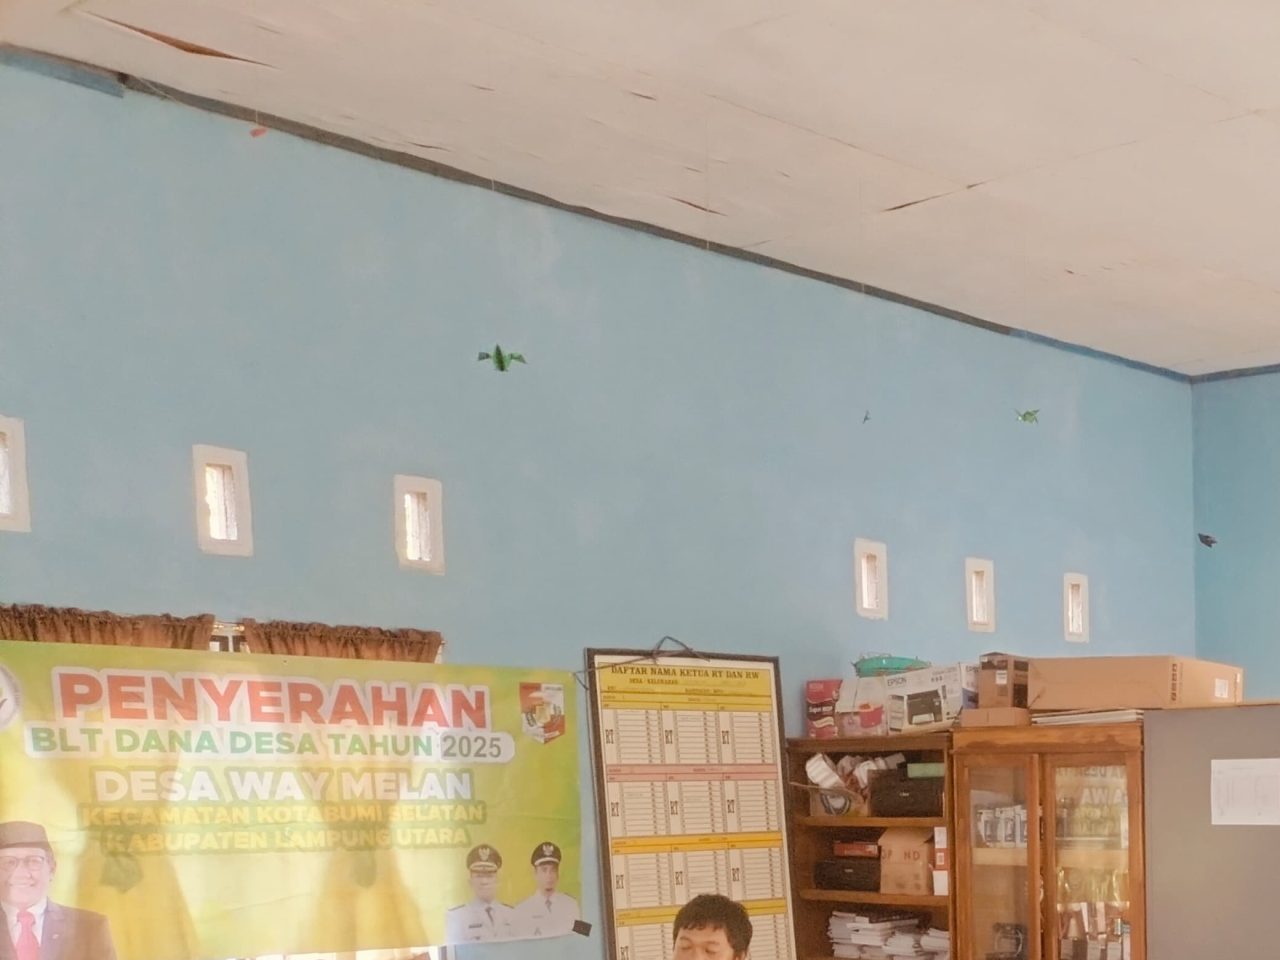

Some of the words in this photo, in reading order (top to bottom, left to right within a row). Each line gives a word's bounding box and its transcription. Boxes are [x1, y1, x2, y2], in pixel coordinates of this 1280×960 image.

[611, 666, 647, 675] DAFTAR
[651, 667, 677, 676] NAMA
[680, 668, 709, 678] KETUA
[712, 670, 723, 678] RT
[726, 671, 743, 679] DAN
[746, 671, 759, 680] RW
[59, 673, 487, 728] PENYERAHAN
[31, 727, 102, 752] BLT
[115, 729, 218, 753] DANA
[229, 731, 319, 755] DESA
[328, 734, 432, 756] TAHUN
[442, 736, 502, 758] 2025
[95, 770, 219, 801] DESA
[228, 771, 330, 801] WAY
[342, 771, 472, 800] MELAN
[83, 806, 249, 826] KECAMATAN
[257, 804, 382, 824] KOTABUMI
[389, 803, 484, 822] SELATAN
[107, 830, 268, 851] KABUPATEN
[276, 828, 389, 849] LAMPUNG
[397, 826, 469, 846] UTARA
